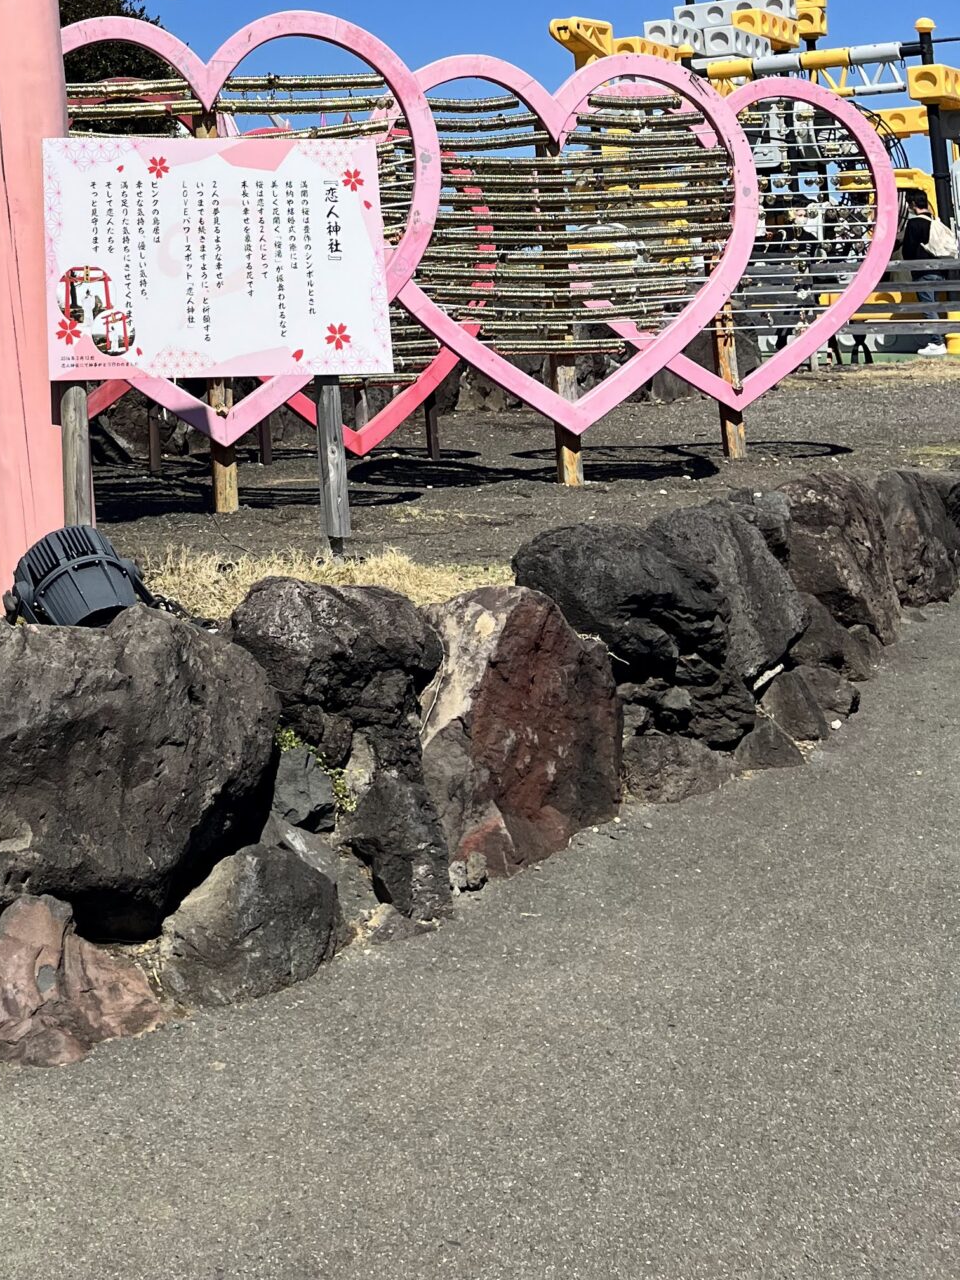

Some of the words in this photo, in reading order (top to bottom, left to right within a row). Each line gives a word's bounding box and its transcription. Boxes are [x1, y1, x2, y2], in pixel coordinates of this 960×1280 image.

[90, 181, 99, 253] そっと見守ります
[105, 181, 115, 254] そして恋人たちを
[151, 181, 161, 244] ピンクの鳥居は
[241, 180, 254, 297] 末長い幸せを象徴する花です
[285, 180, 298, 269] 結納や結婚式の際には
[300, 180, 316, 315] 満開の桜は豊作のシンボルとされ
[323, 180, 343, 261] 『恋人神社』
